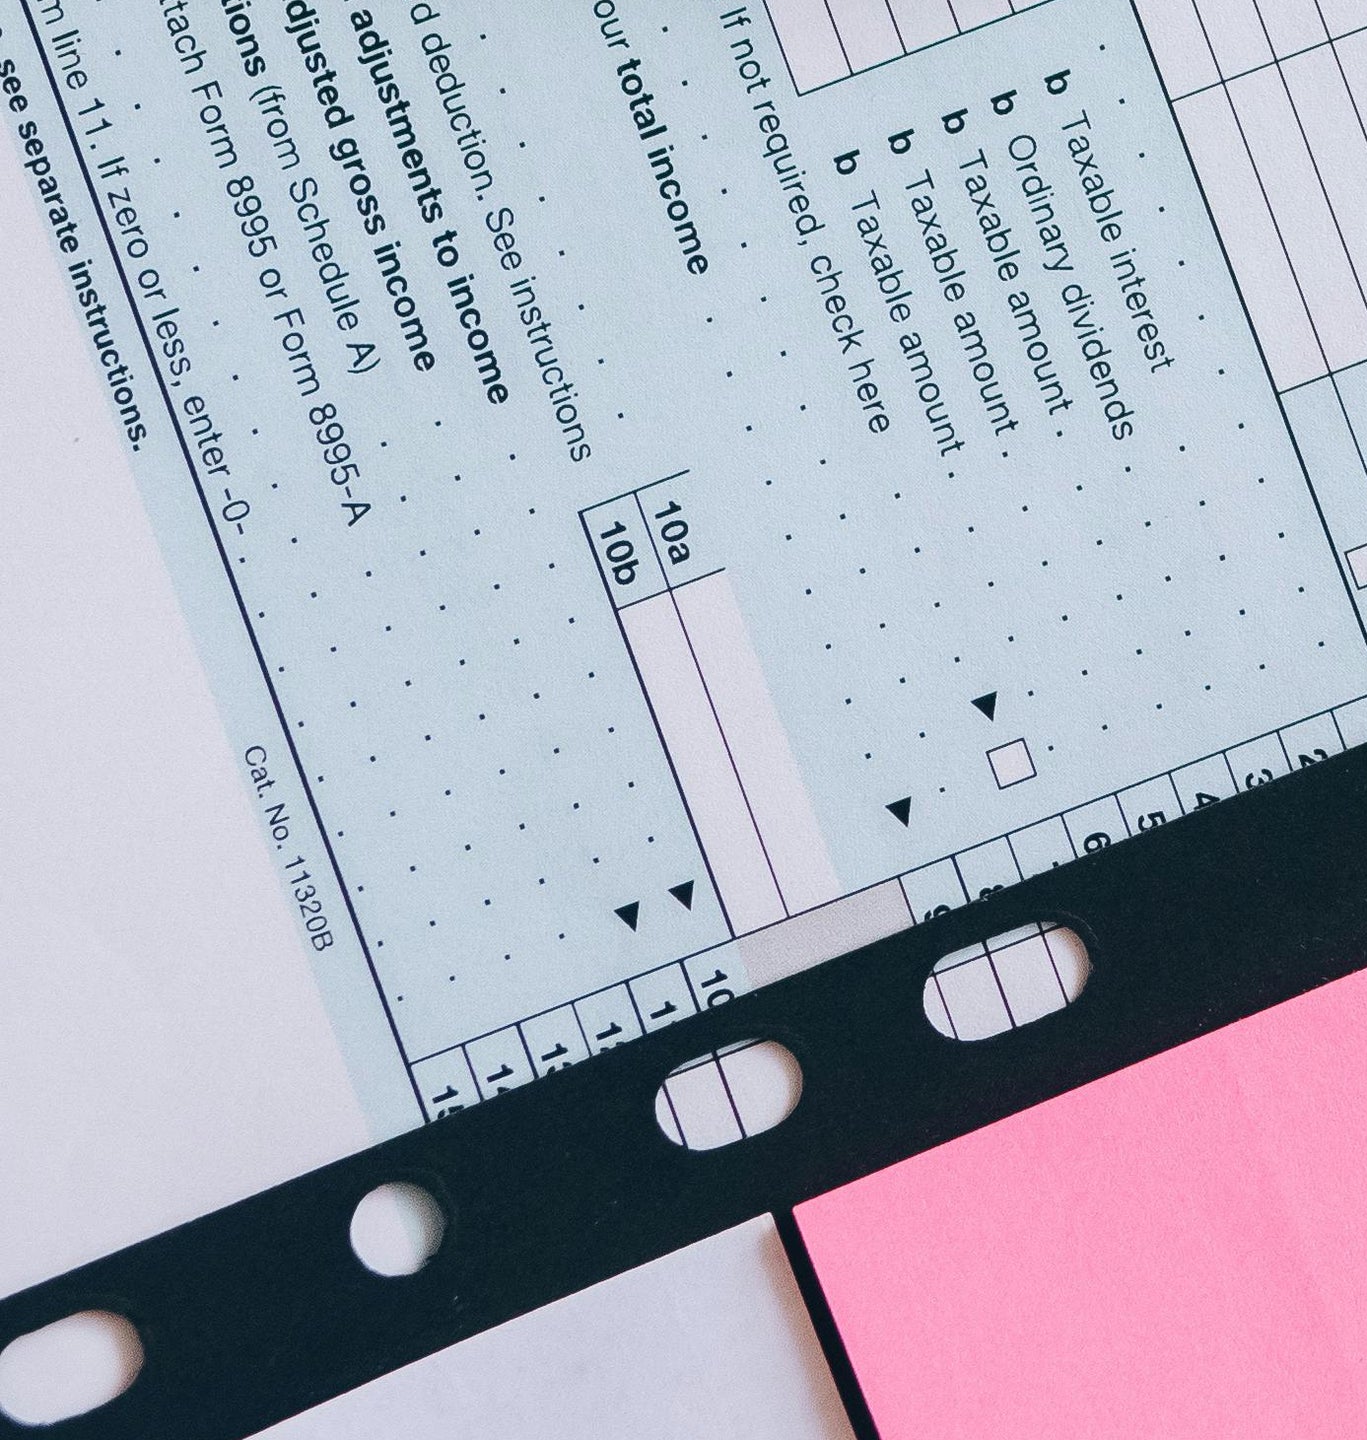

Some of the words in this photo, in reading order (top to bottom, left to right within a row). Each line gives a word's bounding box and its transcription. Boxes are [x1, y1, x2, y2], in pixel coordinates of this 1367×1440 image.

[328, 137, 387, 236] gross
[372, 240, 436, 373] income
[616, 57, 669, 142] total
[647, 144, 709, 276] income
[989, 88, 1018, 117] b
[1007, 134, 1075, 272] Ordinary
[1060, 283, 1136, 441] dividends
[1043, 68, 1072, 96] b
[1061, 108, 1124, 243] Taxable
[1109, 247, 1176, 375] interest
[17, 120, 80, 255] separate
[67, 258, 148, 453] instructions.
[599, 520, 640, 586] 10b
[654, 500, 691, 566] 10a
[244, 744, 276, 799] Cat.
[264, 802, 291, 850] No.
[284, 854, 334, 952] 11320B
